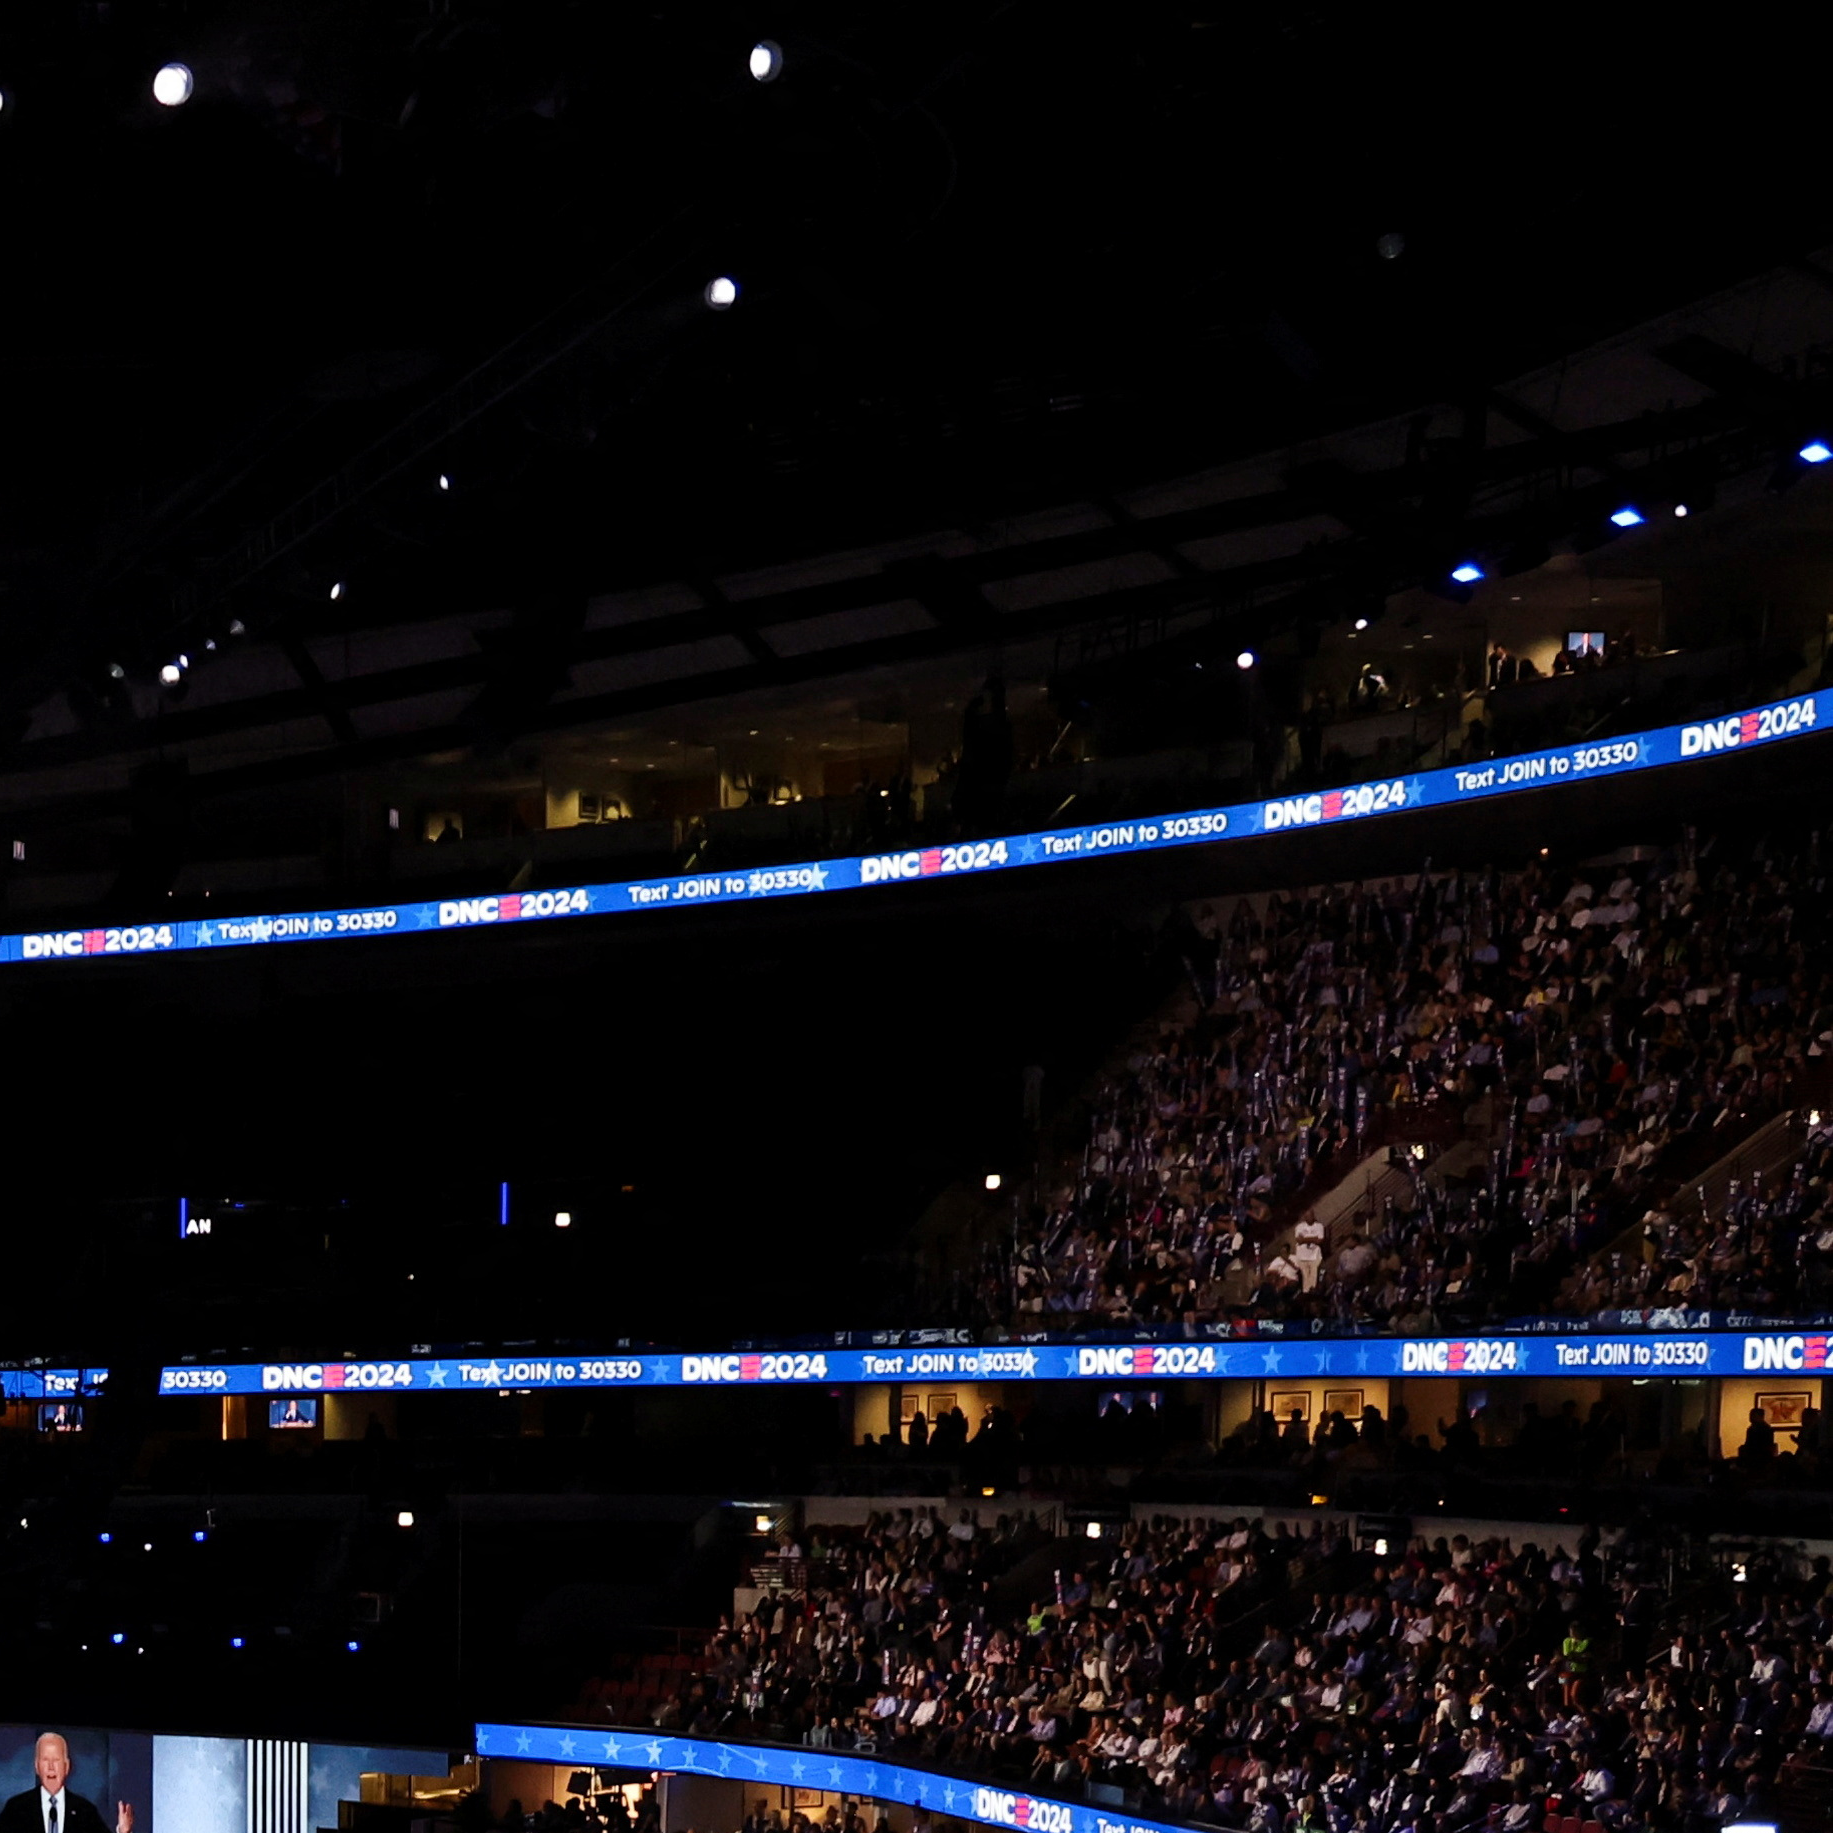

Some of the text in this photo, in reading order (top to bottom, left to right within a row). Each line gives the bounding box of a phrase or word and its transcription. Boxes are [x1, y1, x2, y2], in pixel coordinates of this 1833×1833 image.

[1042, 814, 1226, 854] Text JOIN to 30330
[1557, 1343, 1707, 1366] Text JOIN to 30330
[164, 1371, 226, 1389] 30330
